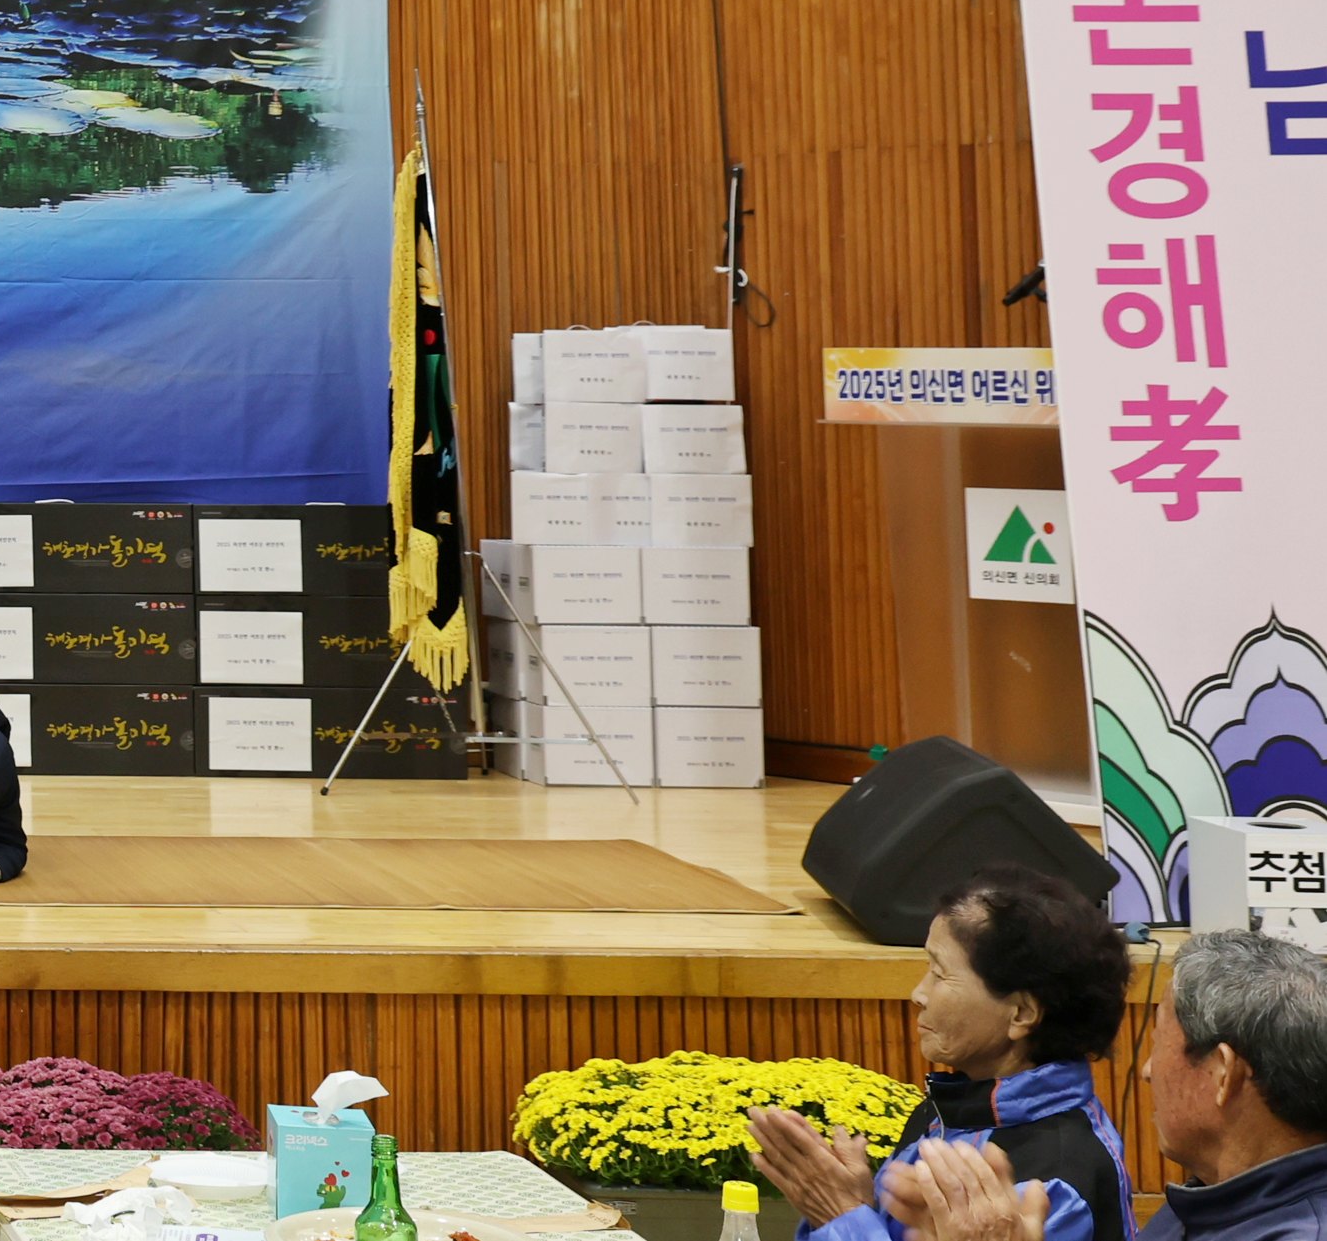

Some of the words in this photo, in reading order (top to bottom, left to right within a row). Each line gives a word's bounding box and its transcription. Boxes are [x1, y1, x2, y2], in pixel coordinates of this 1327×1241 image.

[838, 369, 905, 404] 2025년
[910, 369, 966, 404] 의신면
[972, 369, 1030, 405] 어르신
